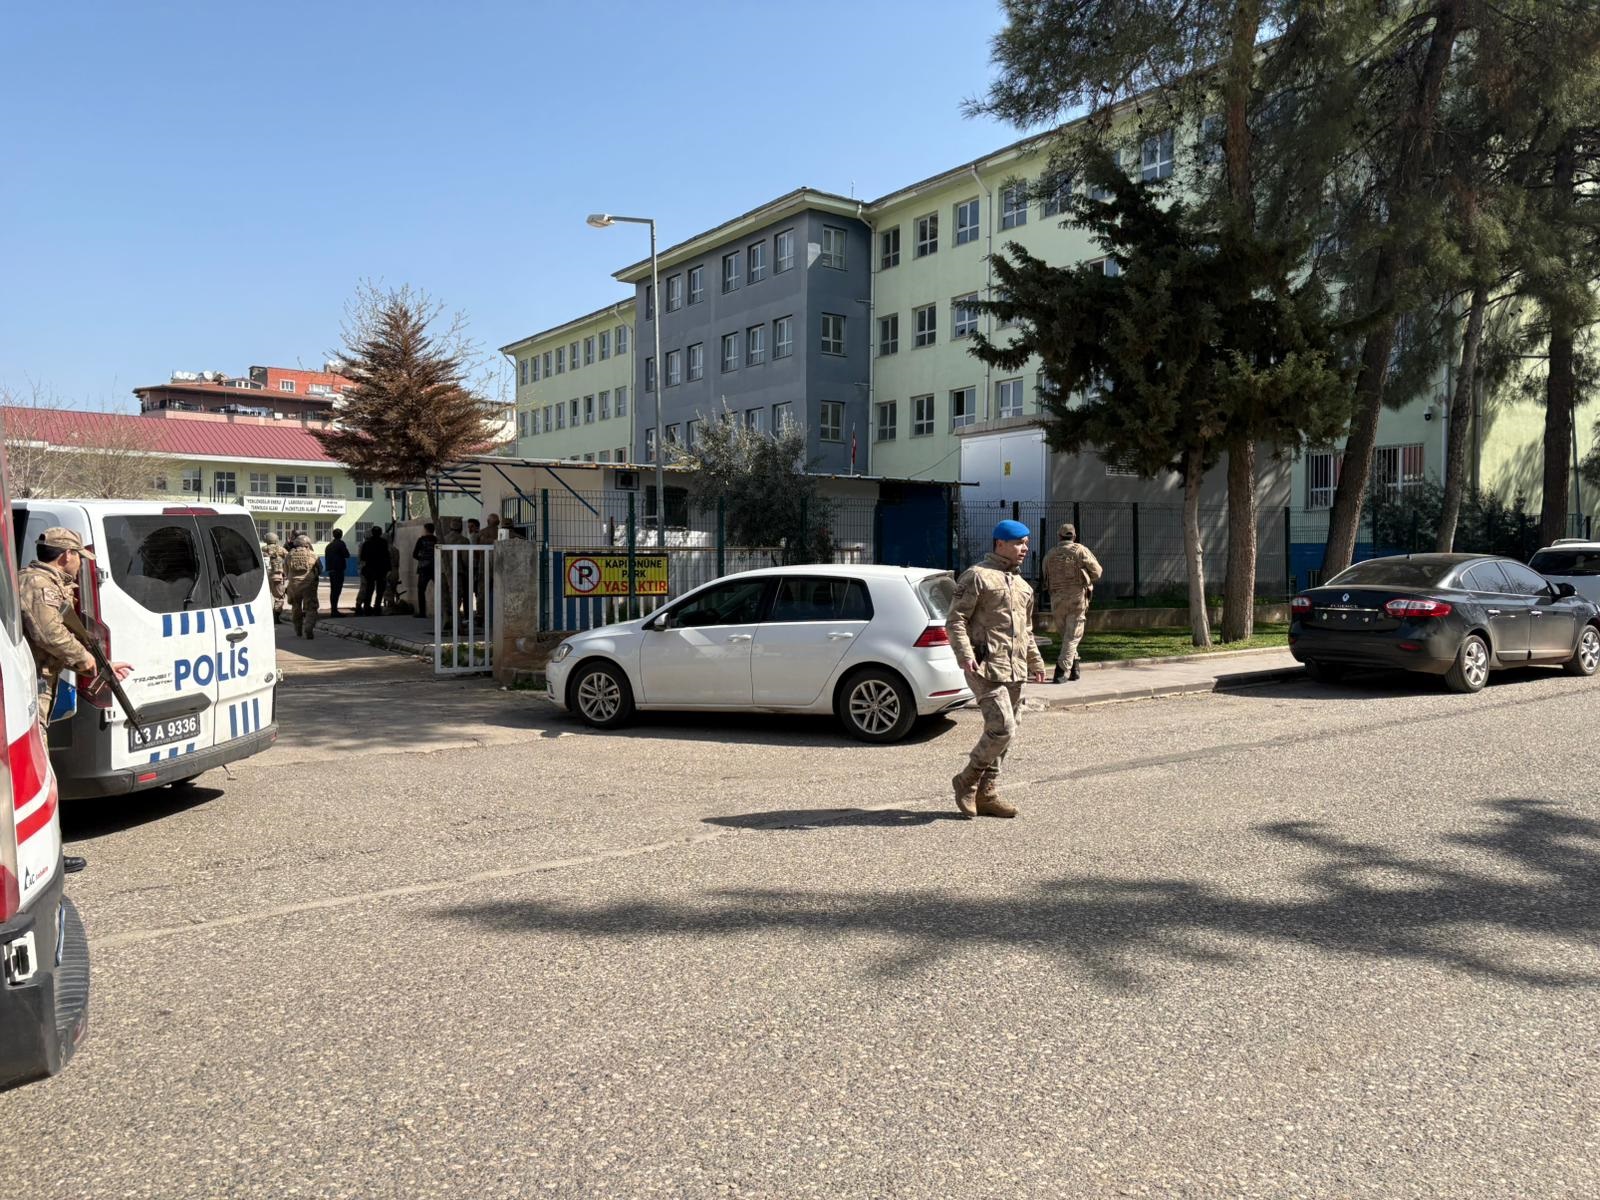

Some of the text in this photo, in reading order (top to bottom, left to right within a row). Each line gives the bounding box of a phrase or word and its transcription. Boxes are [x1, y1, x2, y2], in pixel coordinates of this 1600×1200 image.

[605, 559, 627, 568] KAPI
[622, 570, 646, 578] PRK
[603, 580, 667, 592] YASKTIR
[135, 727, 152, 745] 63
[155, 724, 165, 740] A
[167, 717, 197, 737] 9336
